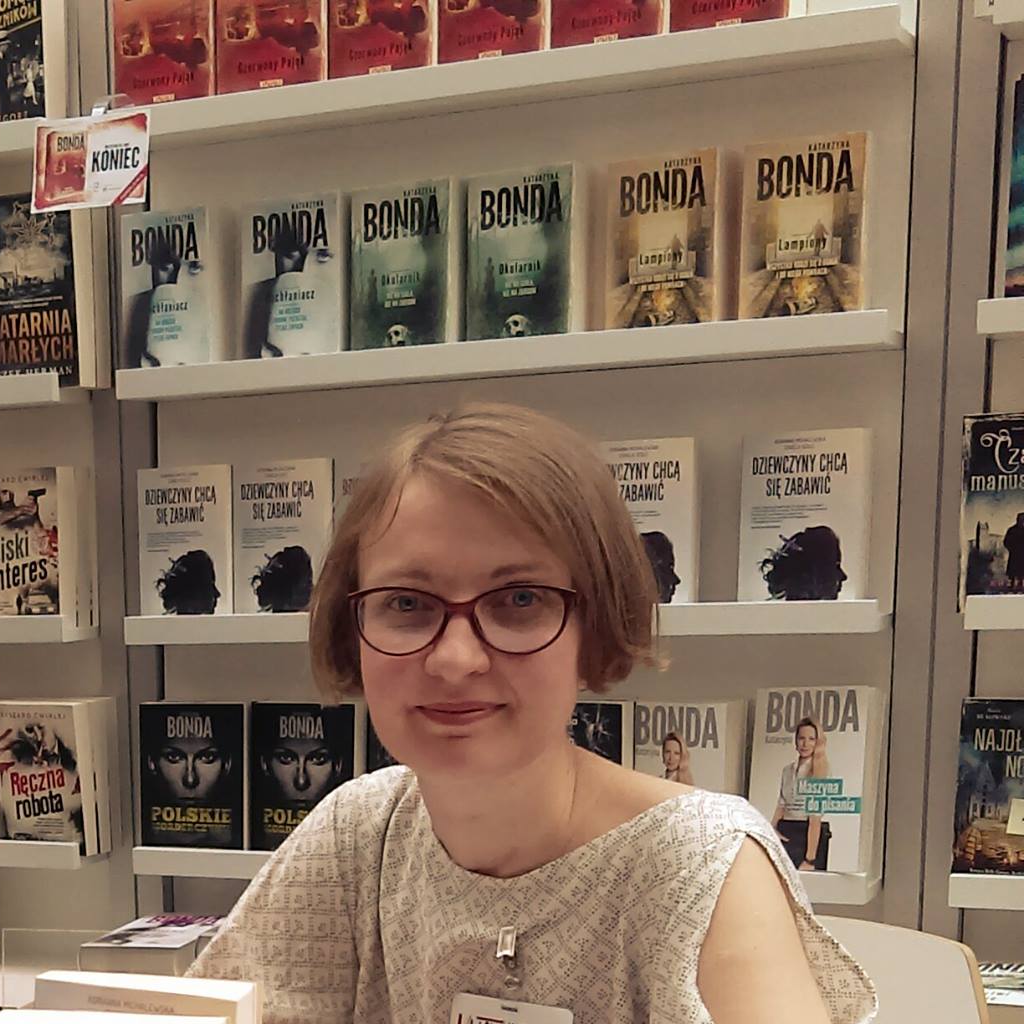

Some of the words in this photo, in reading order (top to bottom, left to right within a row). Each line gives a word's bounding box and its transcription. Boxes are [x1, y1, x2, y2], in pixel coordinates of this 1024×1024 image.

[57, 134, 85, 152] BONDA
[807, 140, 851, 152] KATARZYNA
[91, 146, 140, 172] KONIEC
[756, 149, 854, 201] BONDA
[620, 165, 707, 217] BONDA
[480, 180, 563, 231] BONDA
[363, 194, 440, 243] BONDA
[252, 208, 329, 254] BONDA
[131, 221, 199, 267] BONDA
[778, 236, 827, 252] Lampiony
[639, 250, 683, 266] Lampiony
[652, 460, 681, 482] CHCĄ
[752, 456, 817, 476] DZIEWCZYNY
[819, 452, 848, 475] CHCĄ
[145, 487, 193, 506] DZIEWCZYNY
[194, 485, 217, 505] CHCĄ
[240, 481, 290, 501] DZIEWCZYNY
[291, 480, 315, 500] CHCĄ
[766, 478, 782, 500] SIĘ
[784, 475, 831, 497] ZABAWIĆ
[156, 507, 169, 527] SIĘ
[169, 504, 205, 525] ZABAWIĆ
[253, 502, 266, 522] SIĘ
[266, 499, 302, 520] ZABAWIĆ
[766, 689, 859, 733] BONDA
[167, 715, 213, 739] BONDA
[279, 715, 324, 739] BONDA
[636, 704, 719, 749] BONDA
[10, 768, 66, 797] Ręczna
[798, 779, 840, 796] Maszyna
[15, 792, 64, 820] robota
[151, 806, 232, 825] POLSKIE
[807, 799, 819, 812] do
[820, 798, 857, 812] pisania
